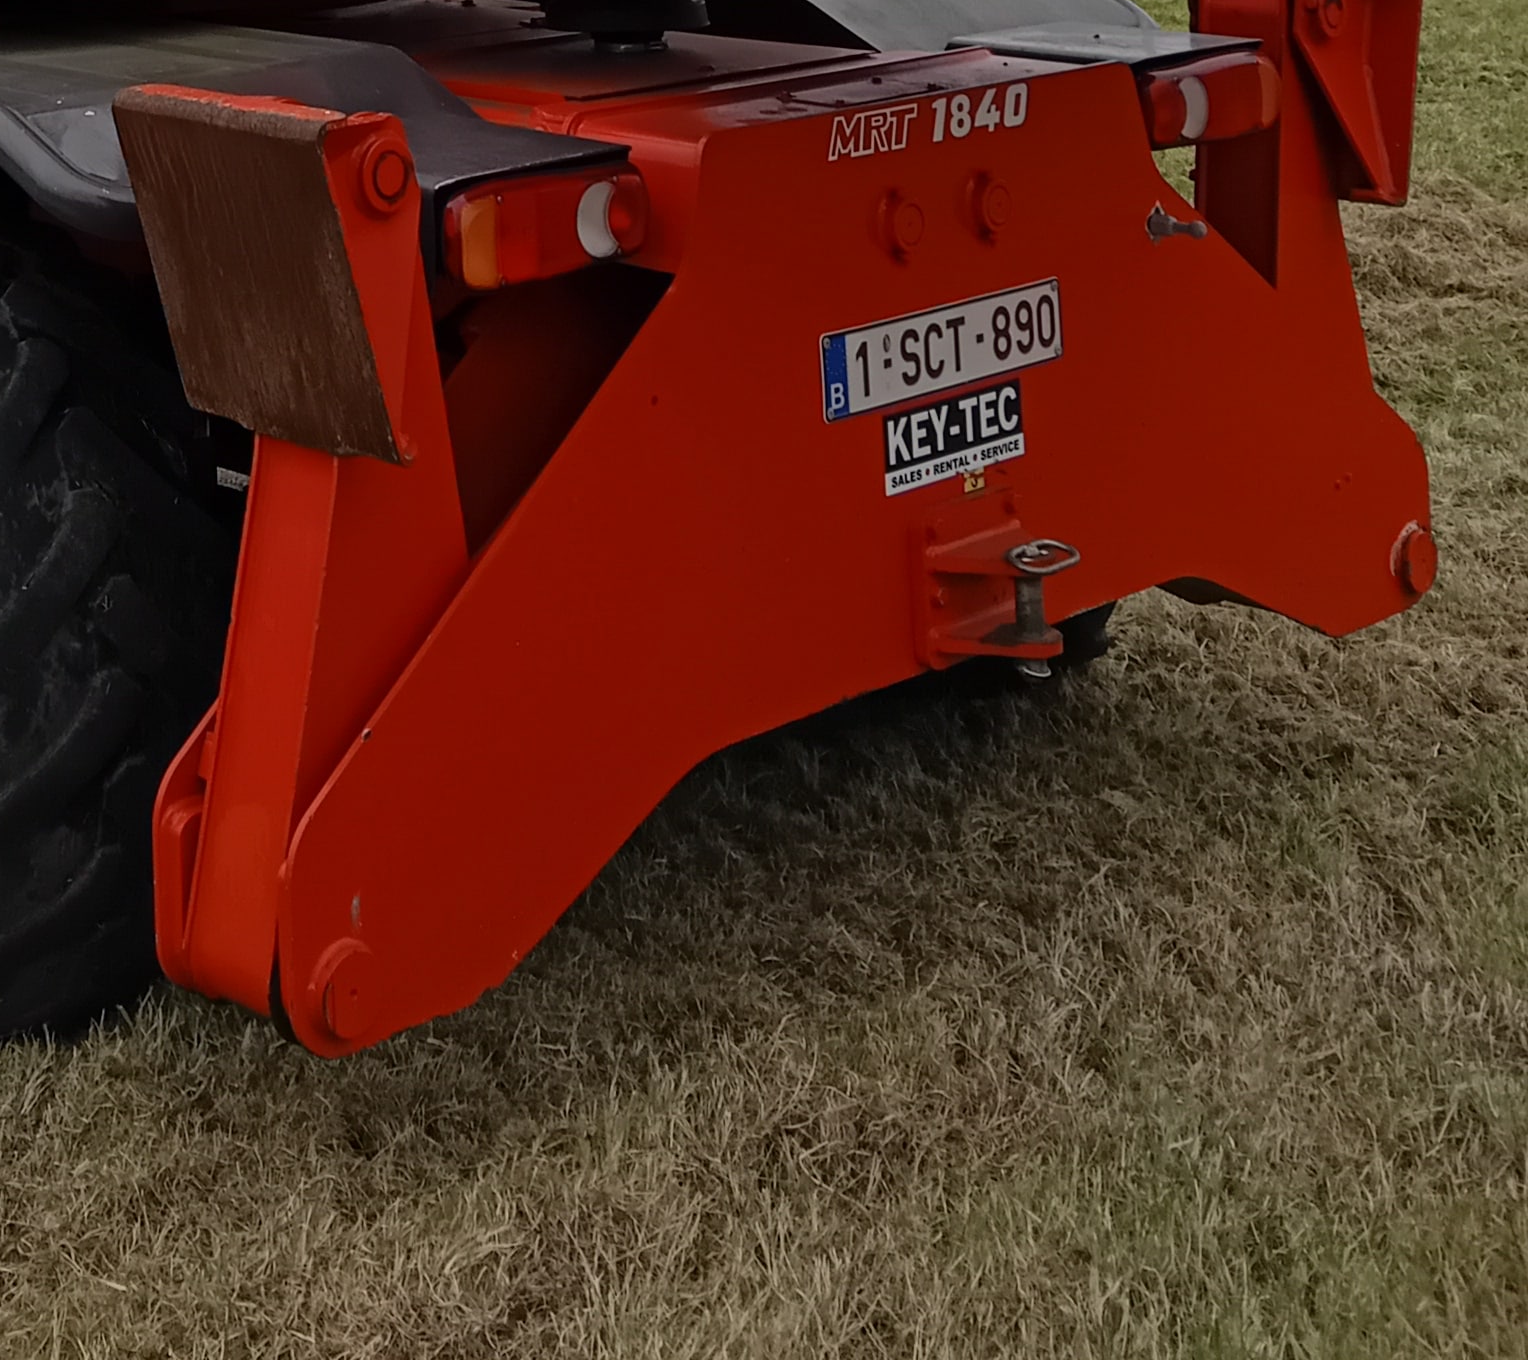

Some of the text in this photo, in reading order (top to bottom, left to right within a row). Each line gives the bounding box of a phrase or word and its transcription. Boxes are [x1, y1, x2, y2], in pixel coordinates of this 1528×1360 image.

[828, 82, 1028, 161] MRT 1840
[830, 382, 845, 410] B
[886, 386, 1019, 466] KEY-TEC
[891, 439, 1020, 489] SALES RENTAL SERVICE
